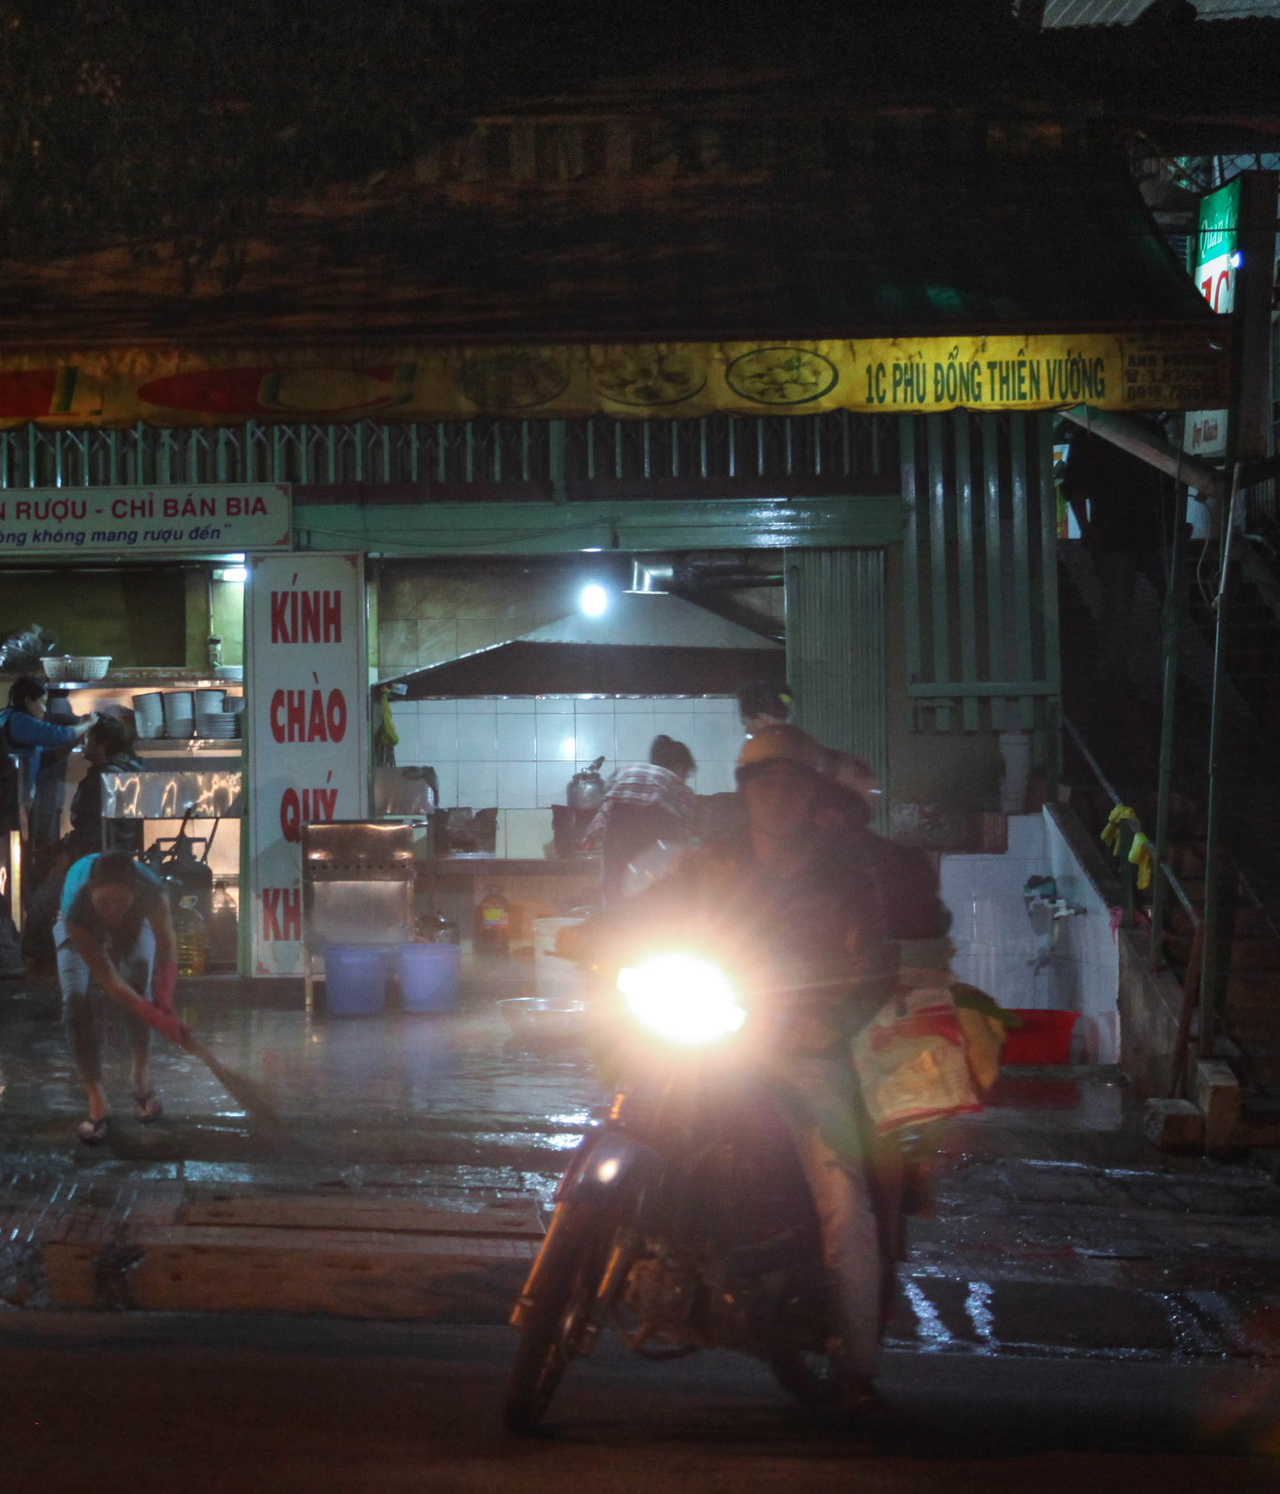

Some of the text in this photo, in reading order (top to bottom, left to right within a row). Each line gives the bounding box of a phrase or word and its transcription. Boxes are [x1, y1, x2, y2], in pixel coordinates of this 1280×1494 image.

[865, 345, 1106, 404] 1C PHÙ ĐỔNG THIÊN VƯƠNG
[16, 498, 87, 523] RƯỢU
[111, 492, 154, 519] CHỈ
[163, 493, 217, 518] BÁN
[226, 496, 268, 516] BIA
[32, 524, 86, 545] không
[91, 529, 138, 545] mang
[144, 528, 184, 543] rượu
[270, 573, 343, 644] KÍNH
[269, 672, 348, 744] CHÀO
